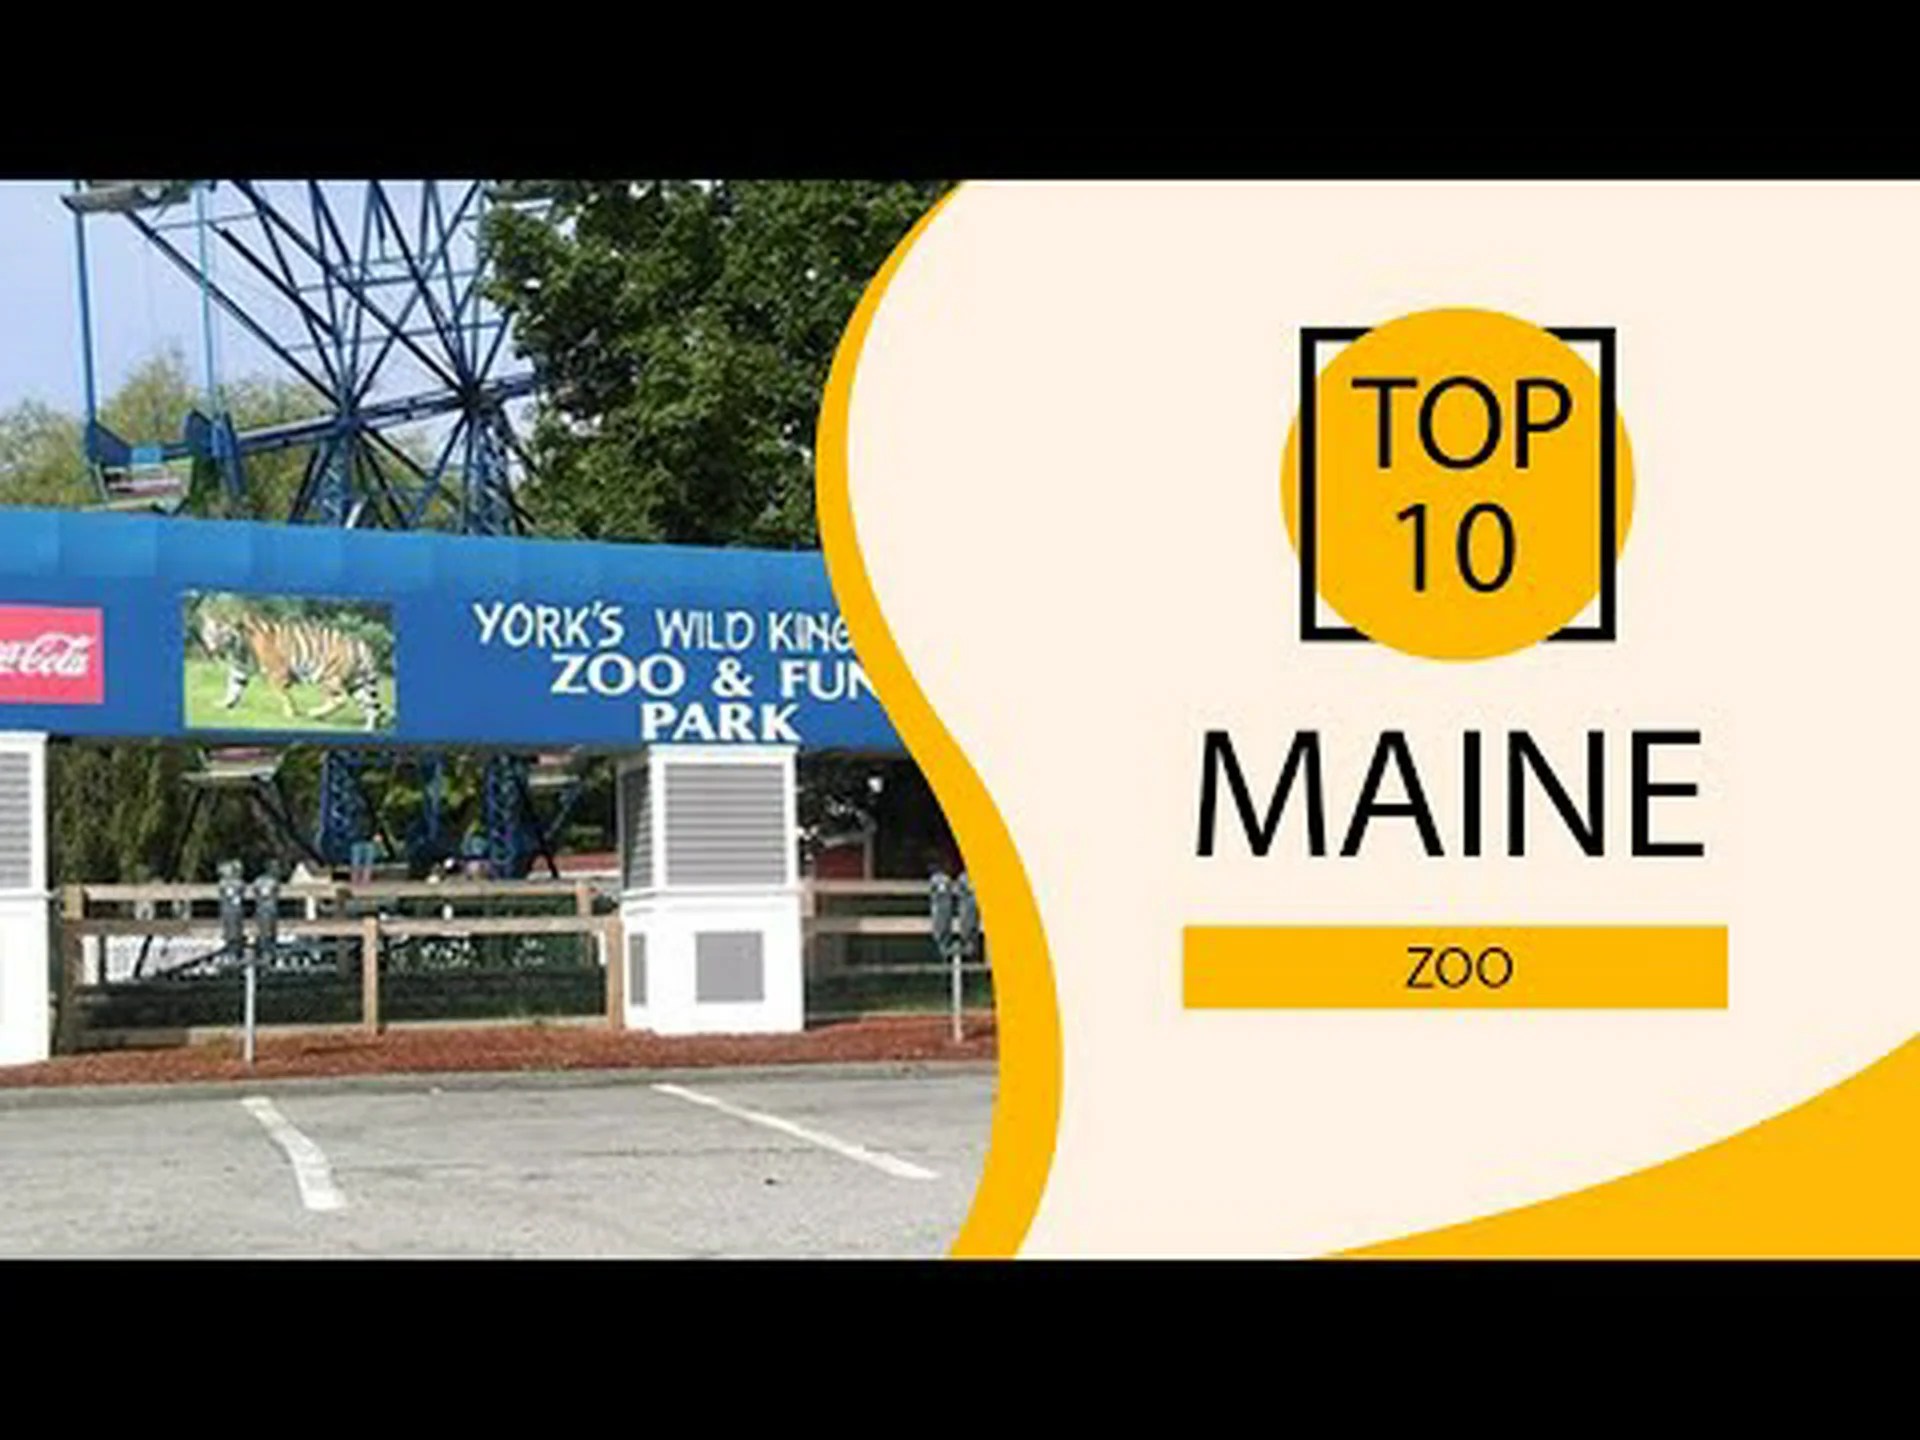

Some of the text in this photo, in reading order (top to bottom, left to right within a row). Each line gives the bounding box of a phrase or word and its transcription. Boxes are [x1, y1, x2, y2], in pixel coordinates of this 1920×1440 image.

[472, 602, 624, 649] YORK'S
[655, 608, 756, 650] WILD
[549, 653, 687, 697] ZOO
[711, 657, 756, 698] &
[640, 703, 802, 742] PARK
